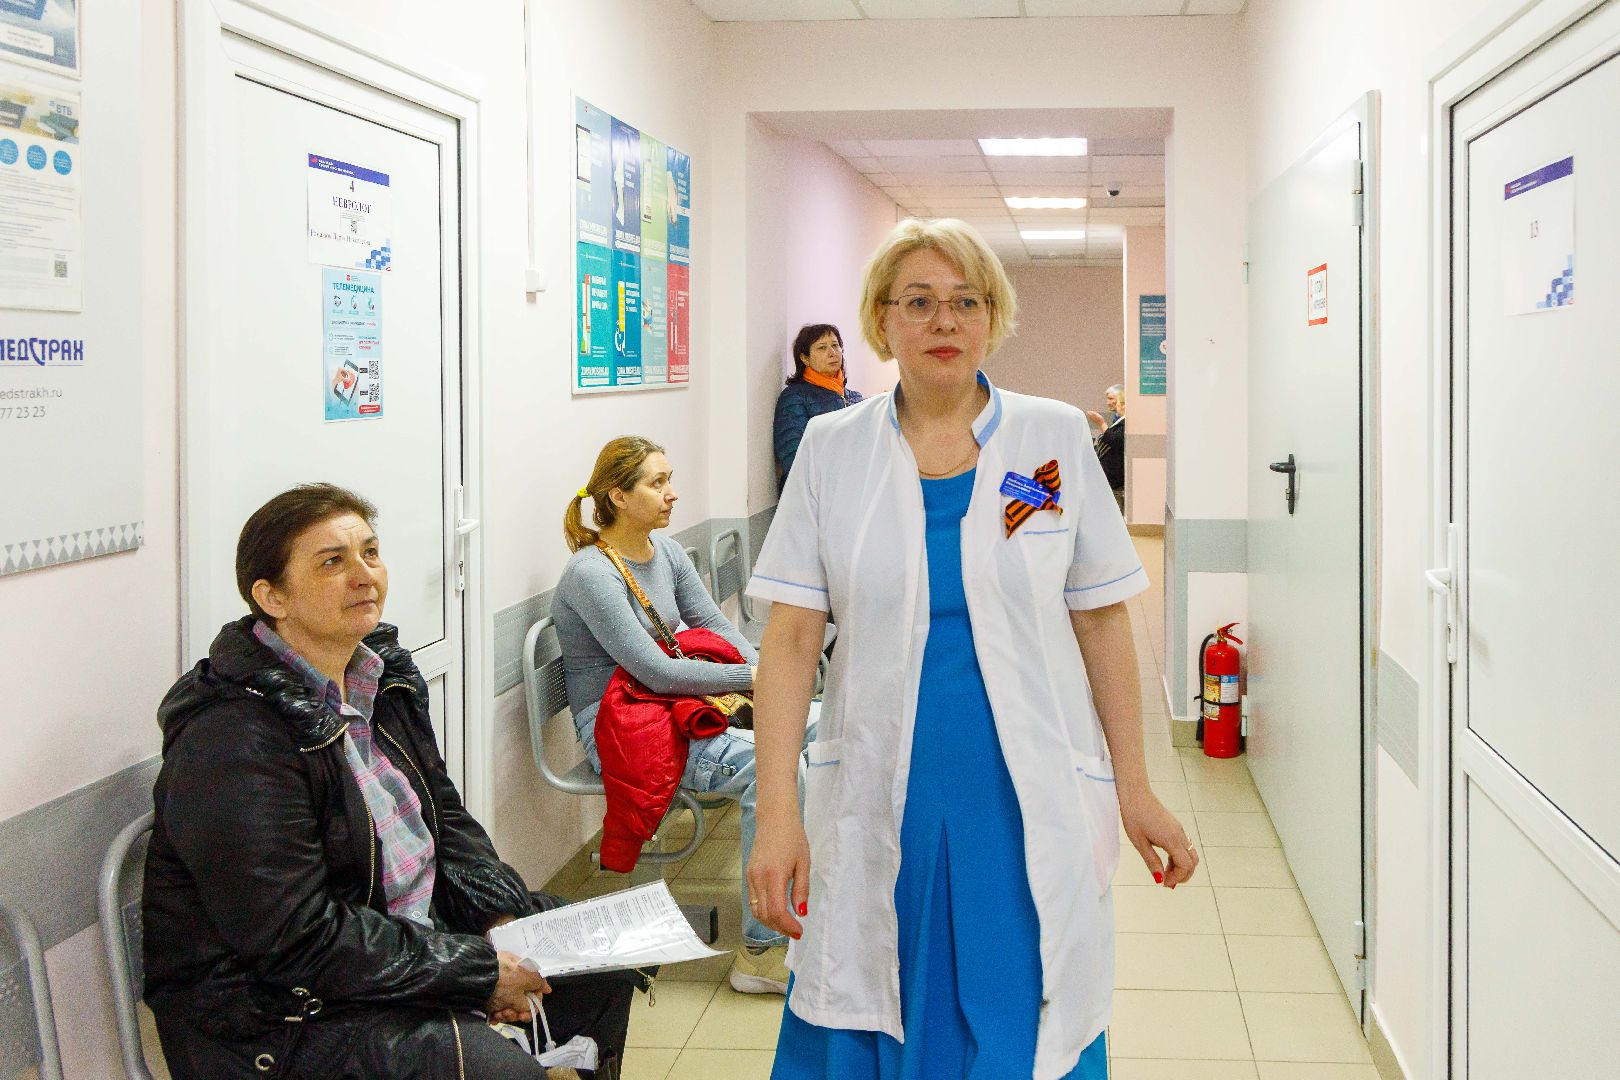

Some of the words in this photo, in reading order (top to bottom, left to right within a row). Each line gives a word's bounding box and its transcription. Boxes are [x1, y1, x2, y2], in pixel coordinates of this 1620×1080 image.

[332, 196, 372, 214] НЕВРОЛОГ
[332, 282, 375, 293] ТЕЛЕМЕДИЦИНА
[16, 407, 30, 419] 23
[33, 406, 46, 418] 23
